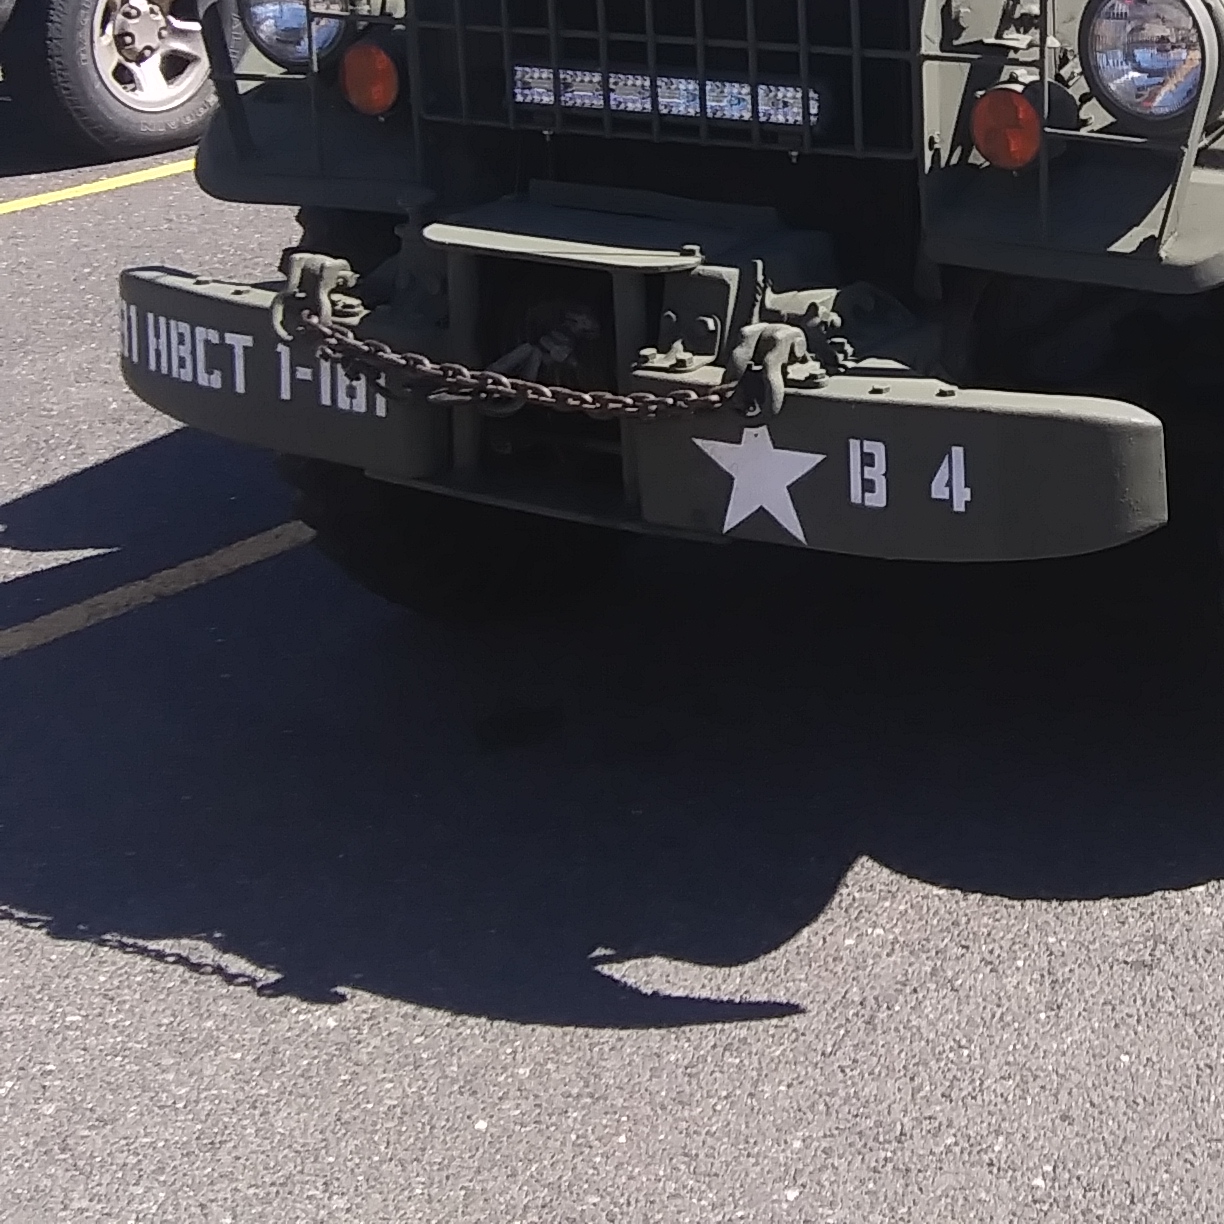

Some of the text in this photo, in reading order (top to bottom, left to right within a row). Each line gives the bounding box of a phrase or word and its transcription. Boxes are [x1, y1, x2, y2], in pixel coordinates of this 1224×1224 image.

[146, 311, 254, 394] HBCT
[848, 437, 972, 512] B 4
